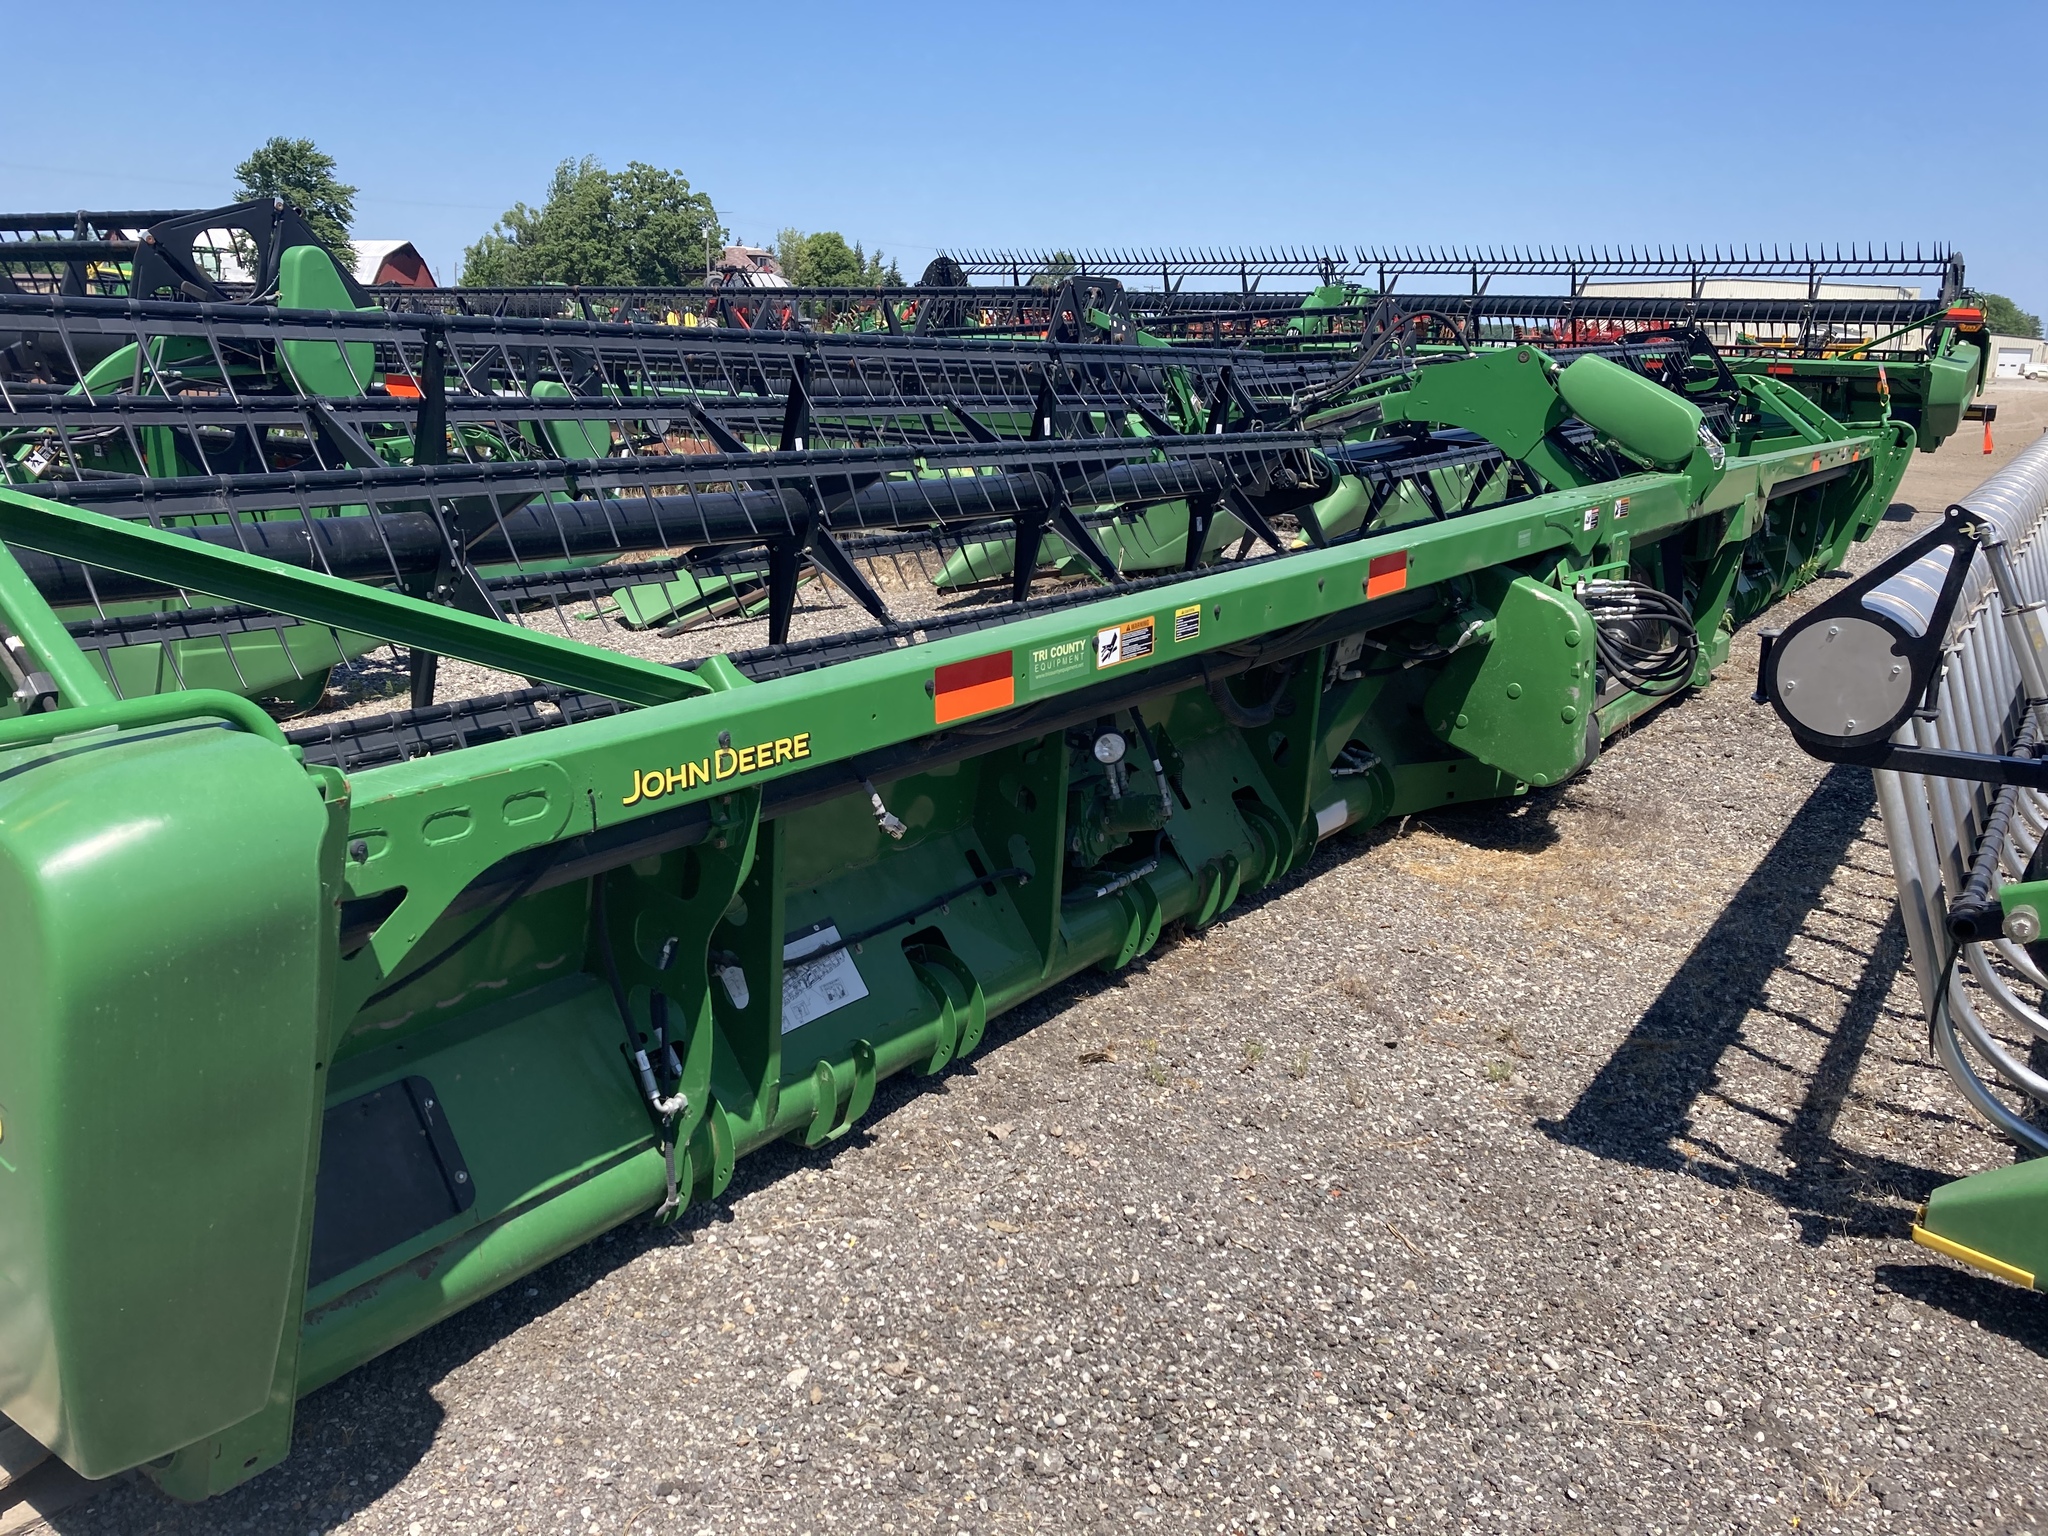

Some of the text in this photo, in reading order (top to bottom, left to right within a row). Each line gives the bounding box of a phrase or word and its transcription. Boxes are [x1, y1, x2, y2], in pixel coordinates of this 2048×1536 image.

[1033, 639, 1087, 663] TRI COUNTY
[1034, 652, 1085, 673] EQUIPMENT
[622, 732, 811, 806] JOHN DEERE
